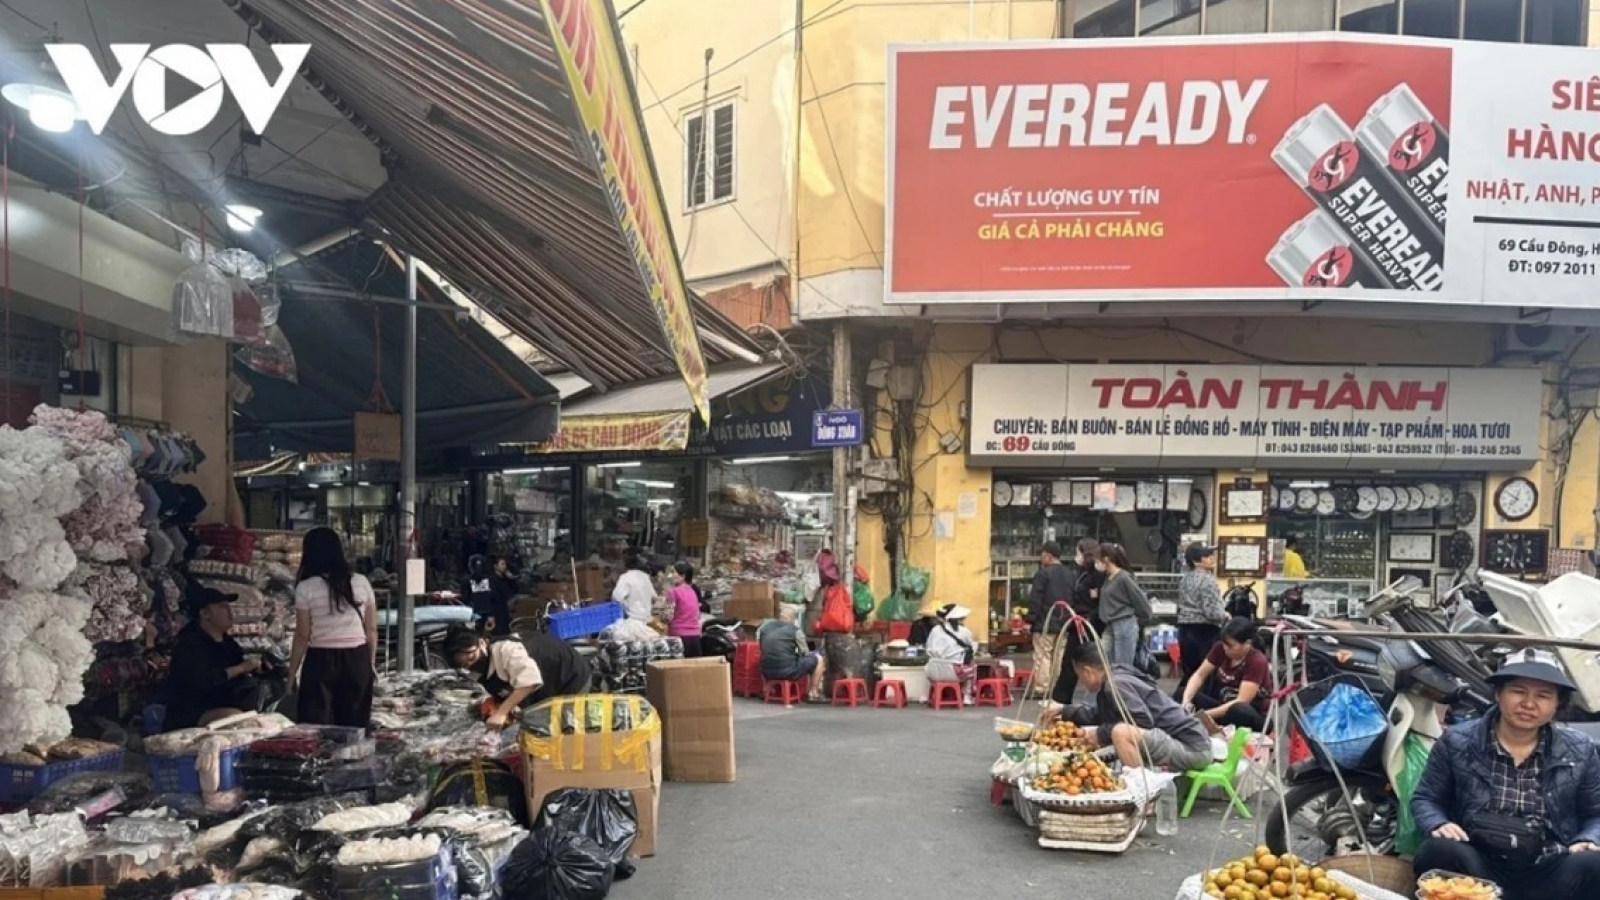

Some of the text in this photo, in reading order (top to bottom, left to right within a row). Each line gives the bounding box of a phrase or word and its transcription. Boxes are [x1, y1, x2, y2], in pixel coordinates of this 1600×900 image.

[929, 78, 1270, 149] EVEREADY
[974, 184, 1160, 210] CHẤT LƯỢNG UY TÍN
[1407, 175, 1447, 223] SUPER
[1466, 178, 1529, 206] NHẬT,
[1535, 183, 1586, 206] ANH,
[978, 218, 1164, 240] GIÁ CẢ PHẢI CHĂNG
[1328, 196, 1409, 283] SUPER HEAVY
[1339, 176, 1445, 292] EVEREAD
[1499, 239, 1517, 252] 69
[1508, 260, 1595, 276] ĐT: 097 2011
[1091, 369, 1447, 411] TOÀN THÀNH
[736, 419, 762, 441] CÁC
[763, 419, 793, 442] LOẠI
[994, 416, 1047, 435] CHUYÊN:
[1051, 416, 1078, 436] BÁN
[1082, 416, 1117, 436] BUÔN
[1125, 416, 1153, 436] BÁN
[1156, 414, 1171, 436] LẺ
[1240, 418, 1268, 437] MÁY
[1272, 418, 1301, 437] TÍNH
[1310, 420, 1338, 440] ĐIỆN
[1342, 419, 1371, 438] MÁY
[1380, 421, 1404, 441] TẠP
[1405, 416, 1444, 438] PHẨM
[1452, 423, 1478, 439] HOA
[1480, 421, 1512, 439] TƯƠI
[1002, 435, 1030, 452] 69
